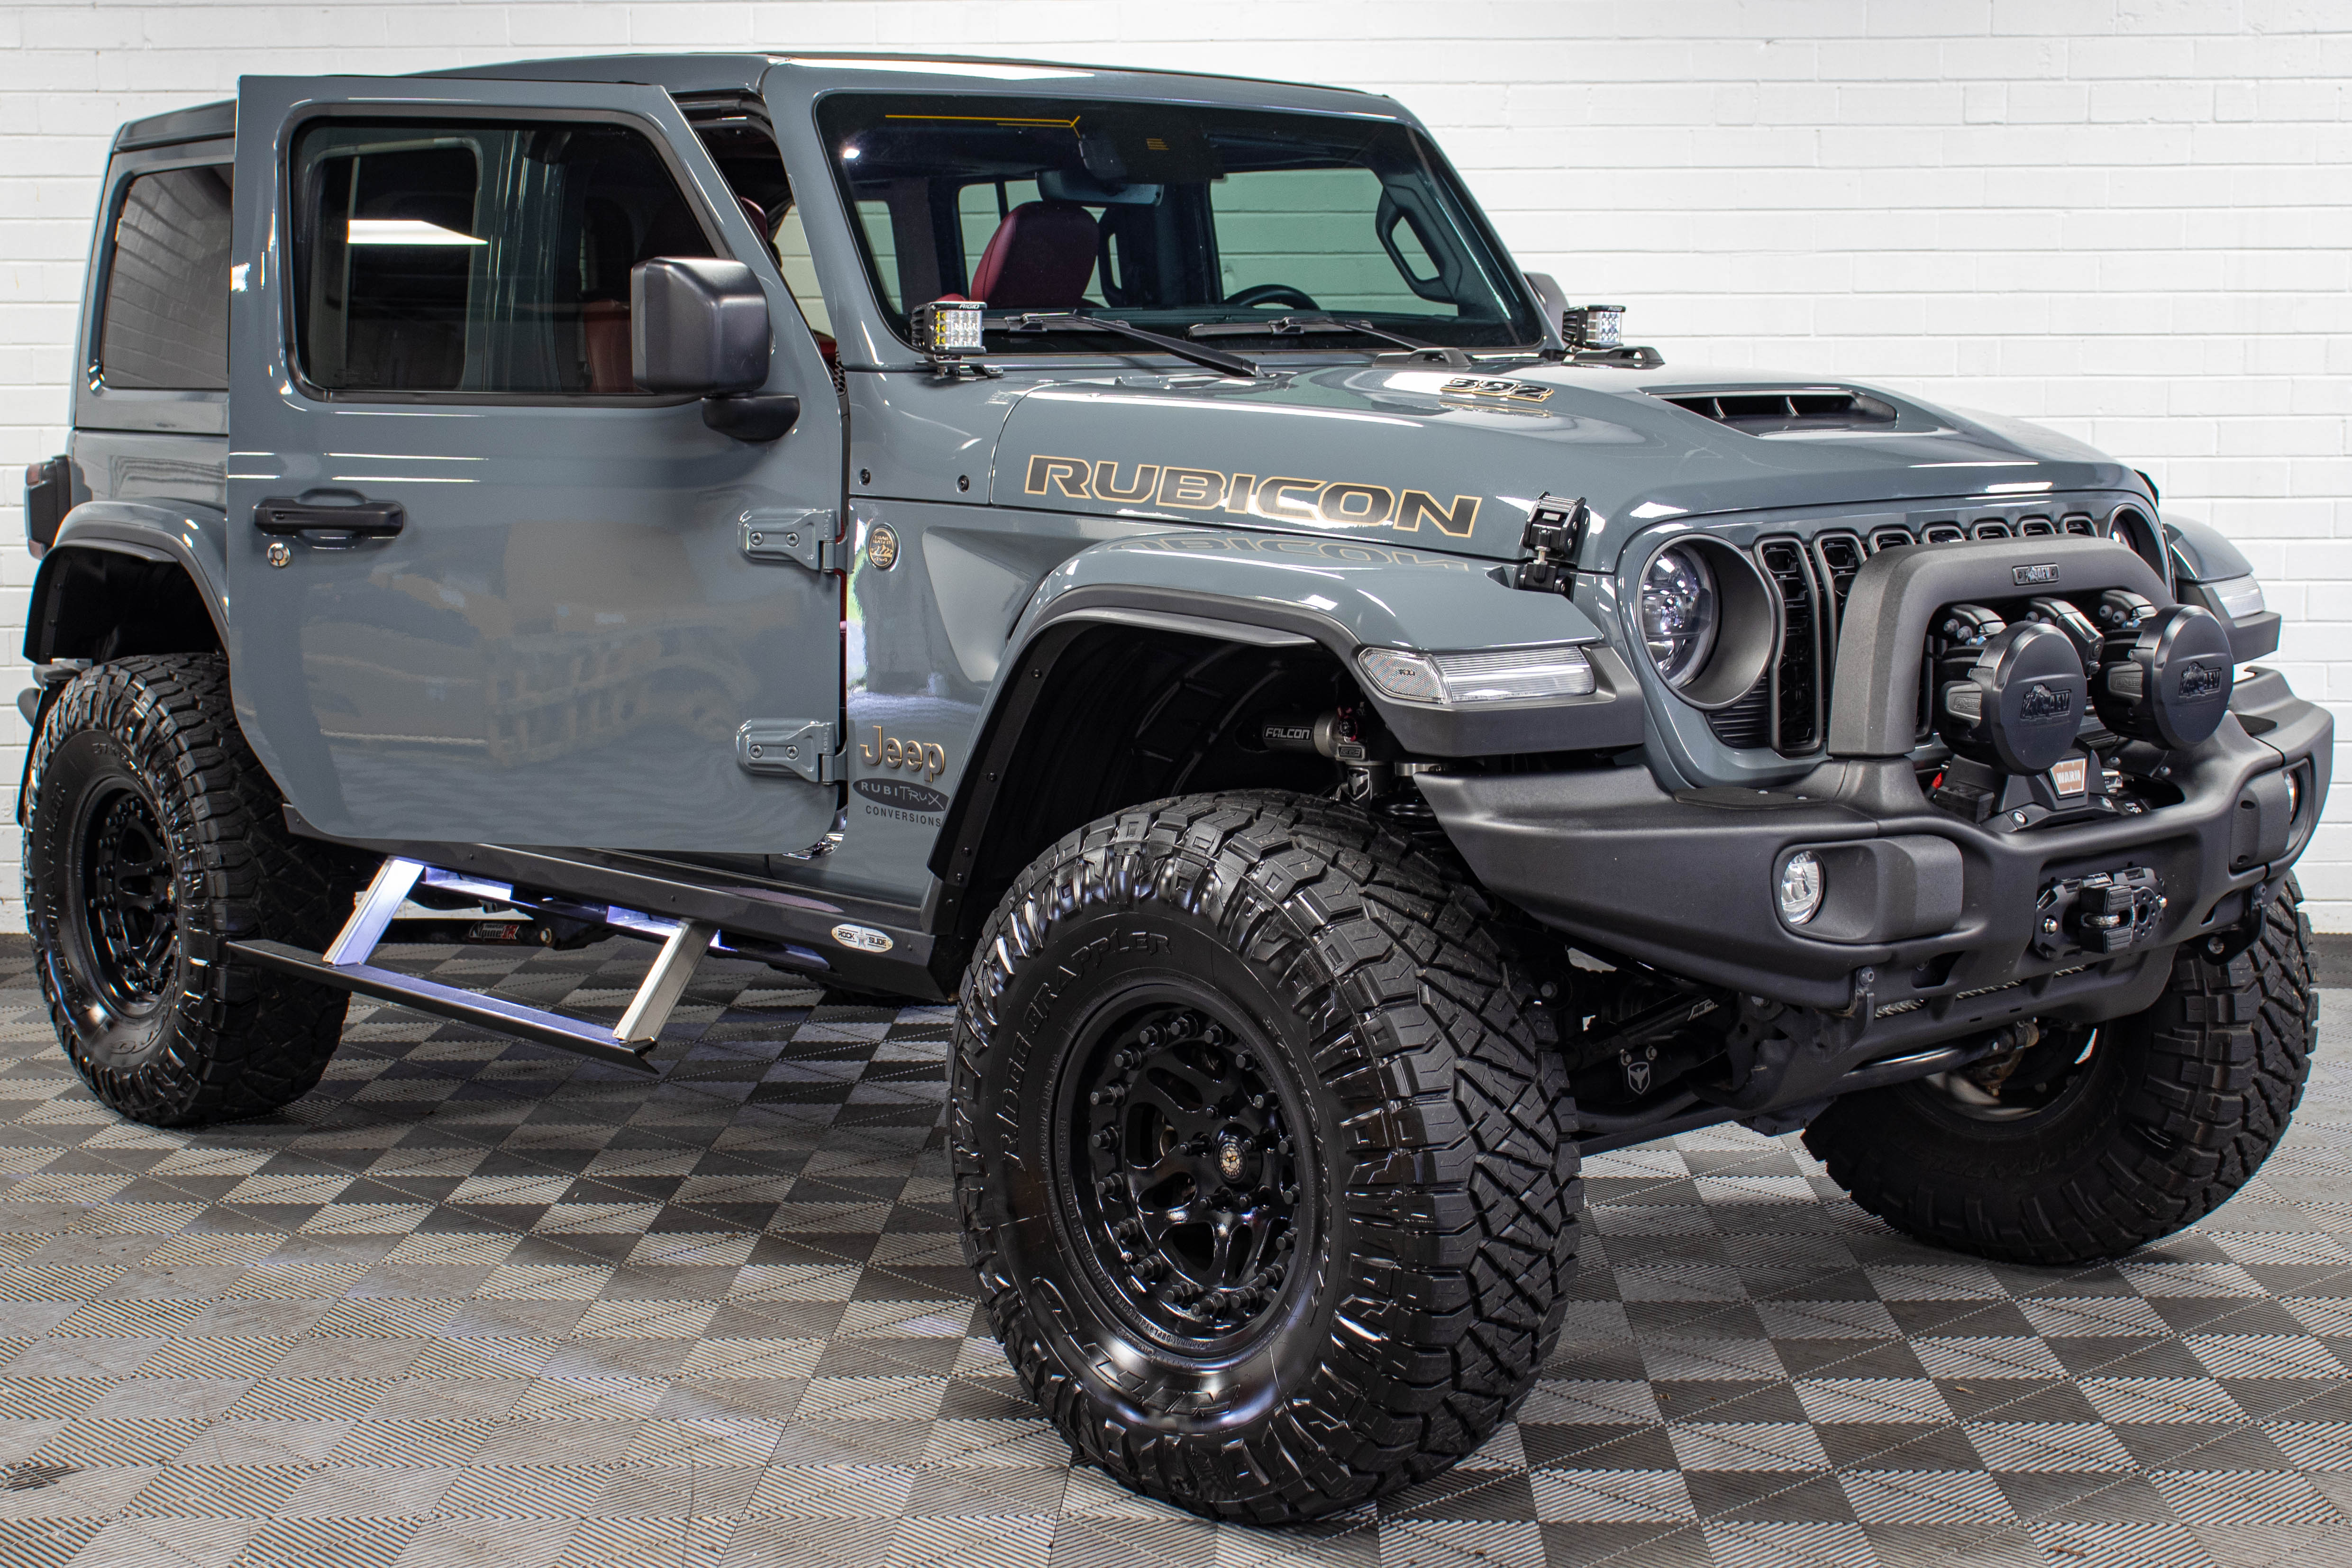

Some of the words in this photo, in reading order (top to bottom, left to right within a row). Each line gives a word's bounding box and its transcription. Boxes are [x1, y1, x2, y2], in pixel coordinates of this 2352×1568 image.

[1440, 378, 1554, 402] 392
[1024, 454, 1483, 538] RUBICON
[1265, 727, 1310, 739] FALCON
[860, 726, 946, 783] Jeep
[2057, 769, 2081, 784] WARN
[866, 805, 941, 827] CONVERSIONS
[838, 930, 855, 939] ROCK
[869, 937, 886, 946] SLIDE
